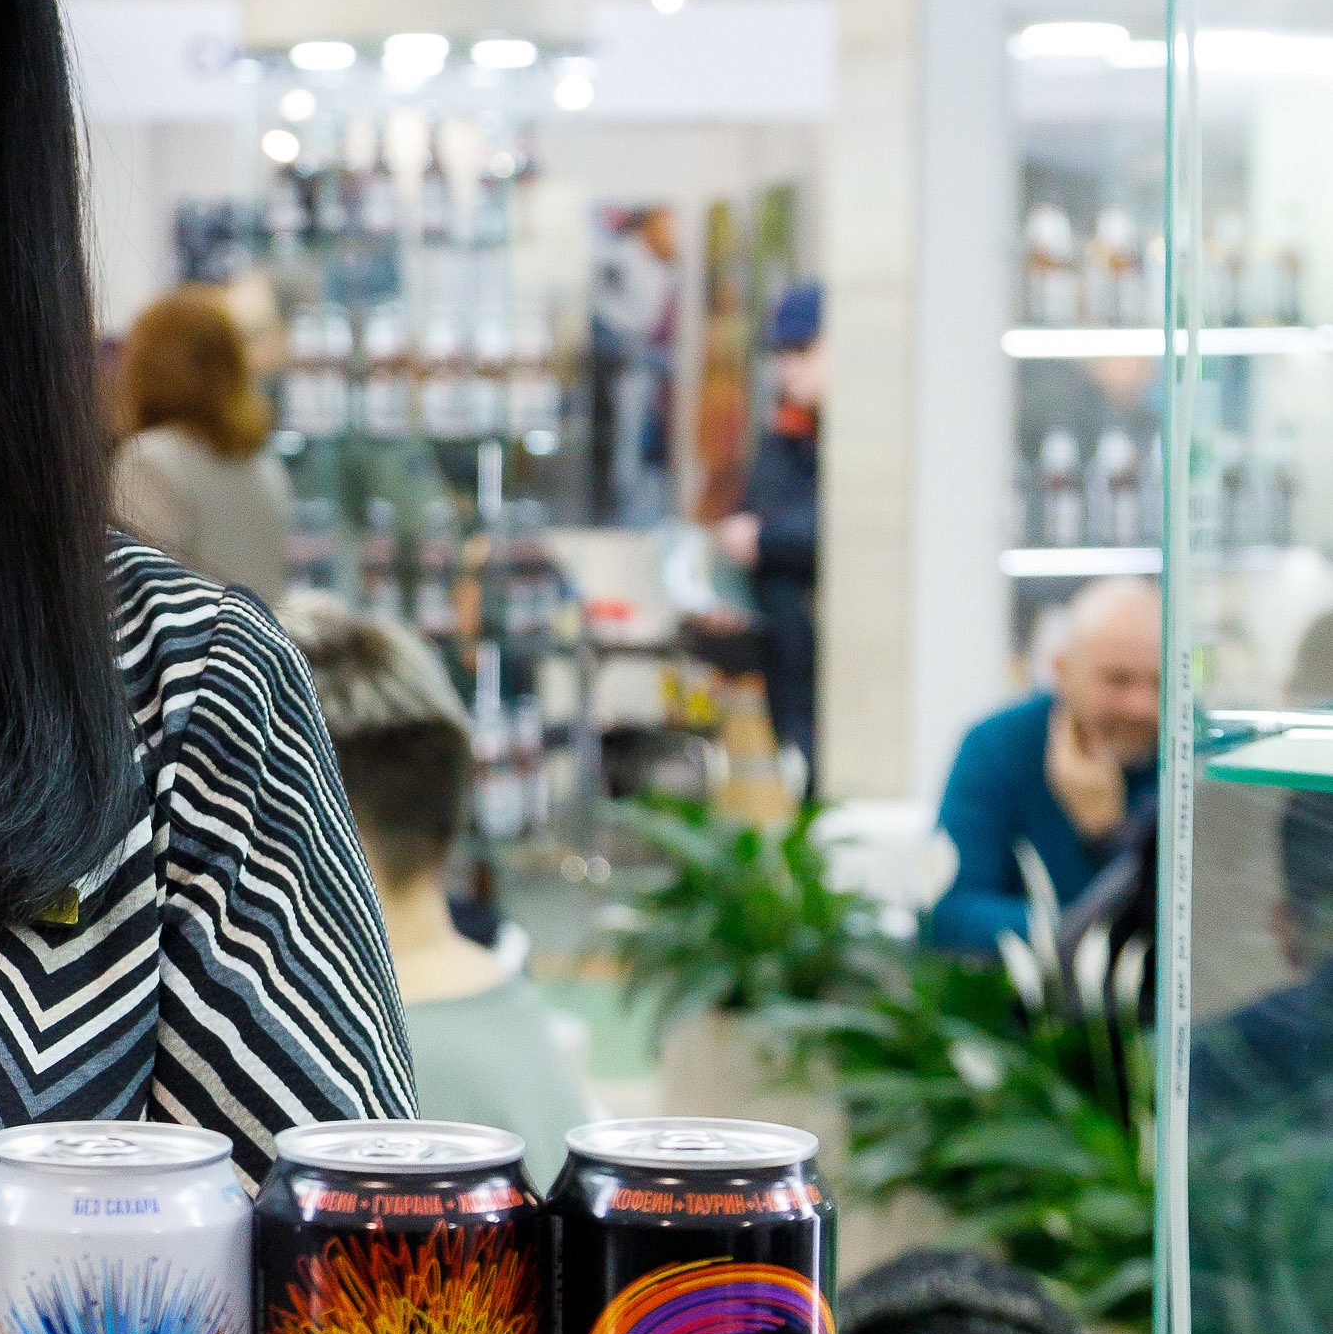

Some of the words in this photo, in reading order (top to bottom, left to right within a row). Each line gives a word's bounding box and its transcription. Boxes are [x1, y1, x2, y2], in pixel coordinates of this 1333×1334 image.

[372, 1194, 444, 1216] ГУАРАНА
[610, 1188, 674, 1214] КОФЕИН
[685, 1192, 746, 1216] ТАУРИН
